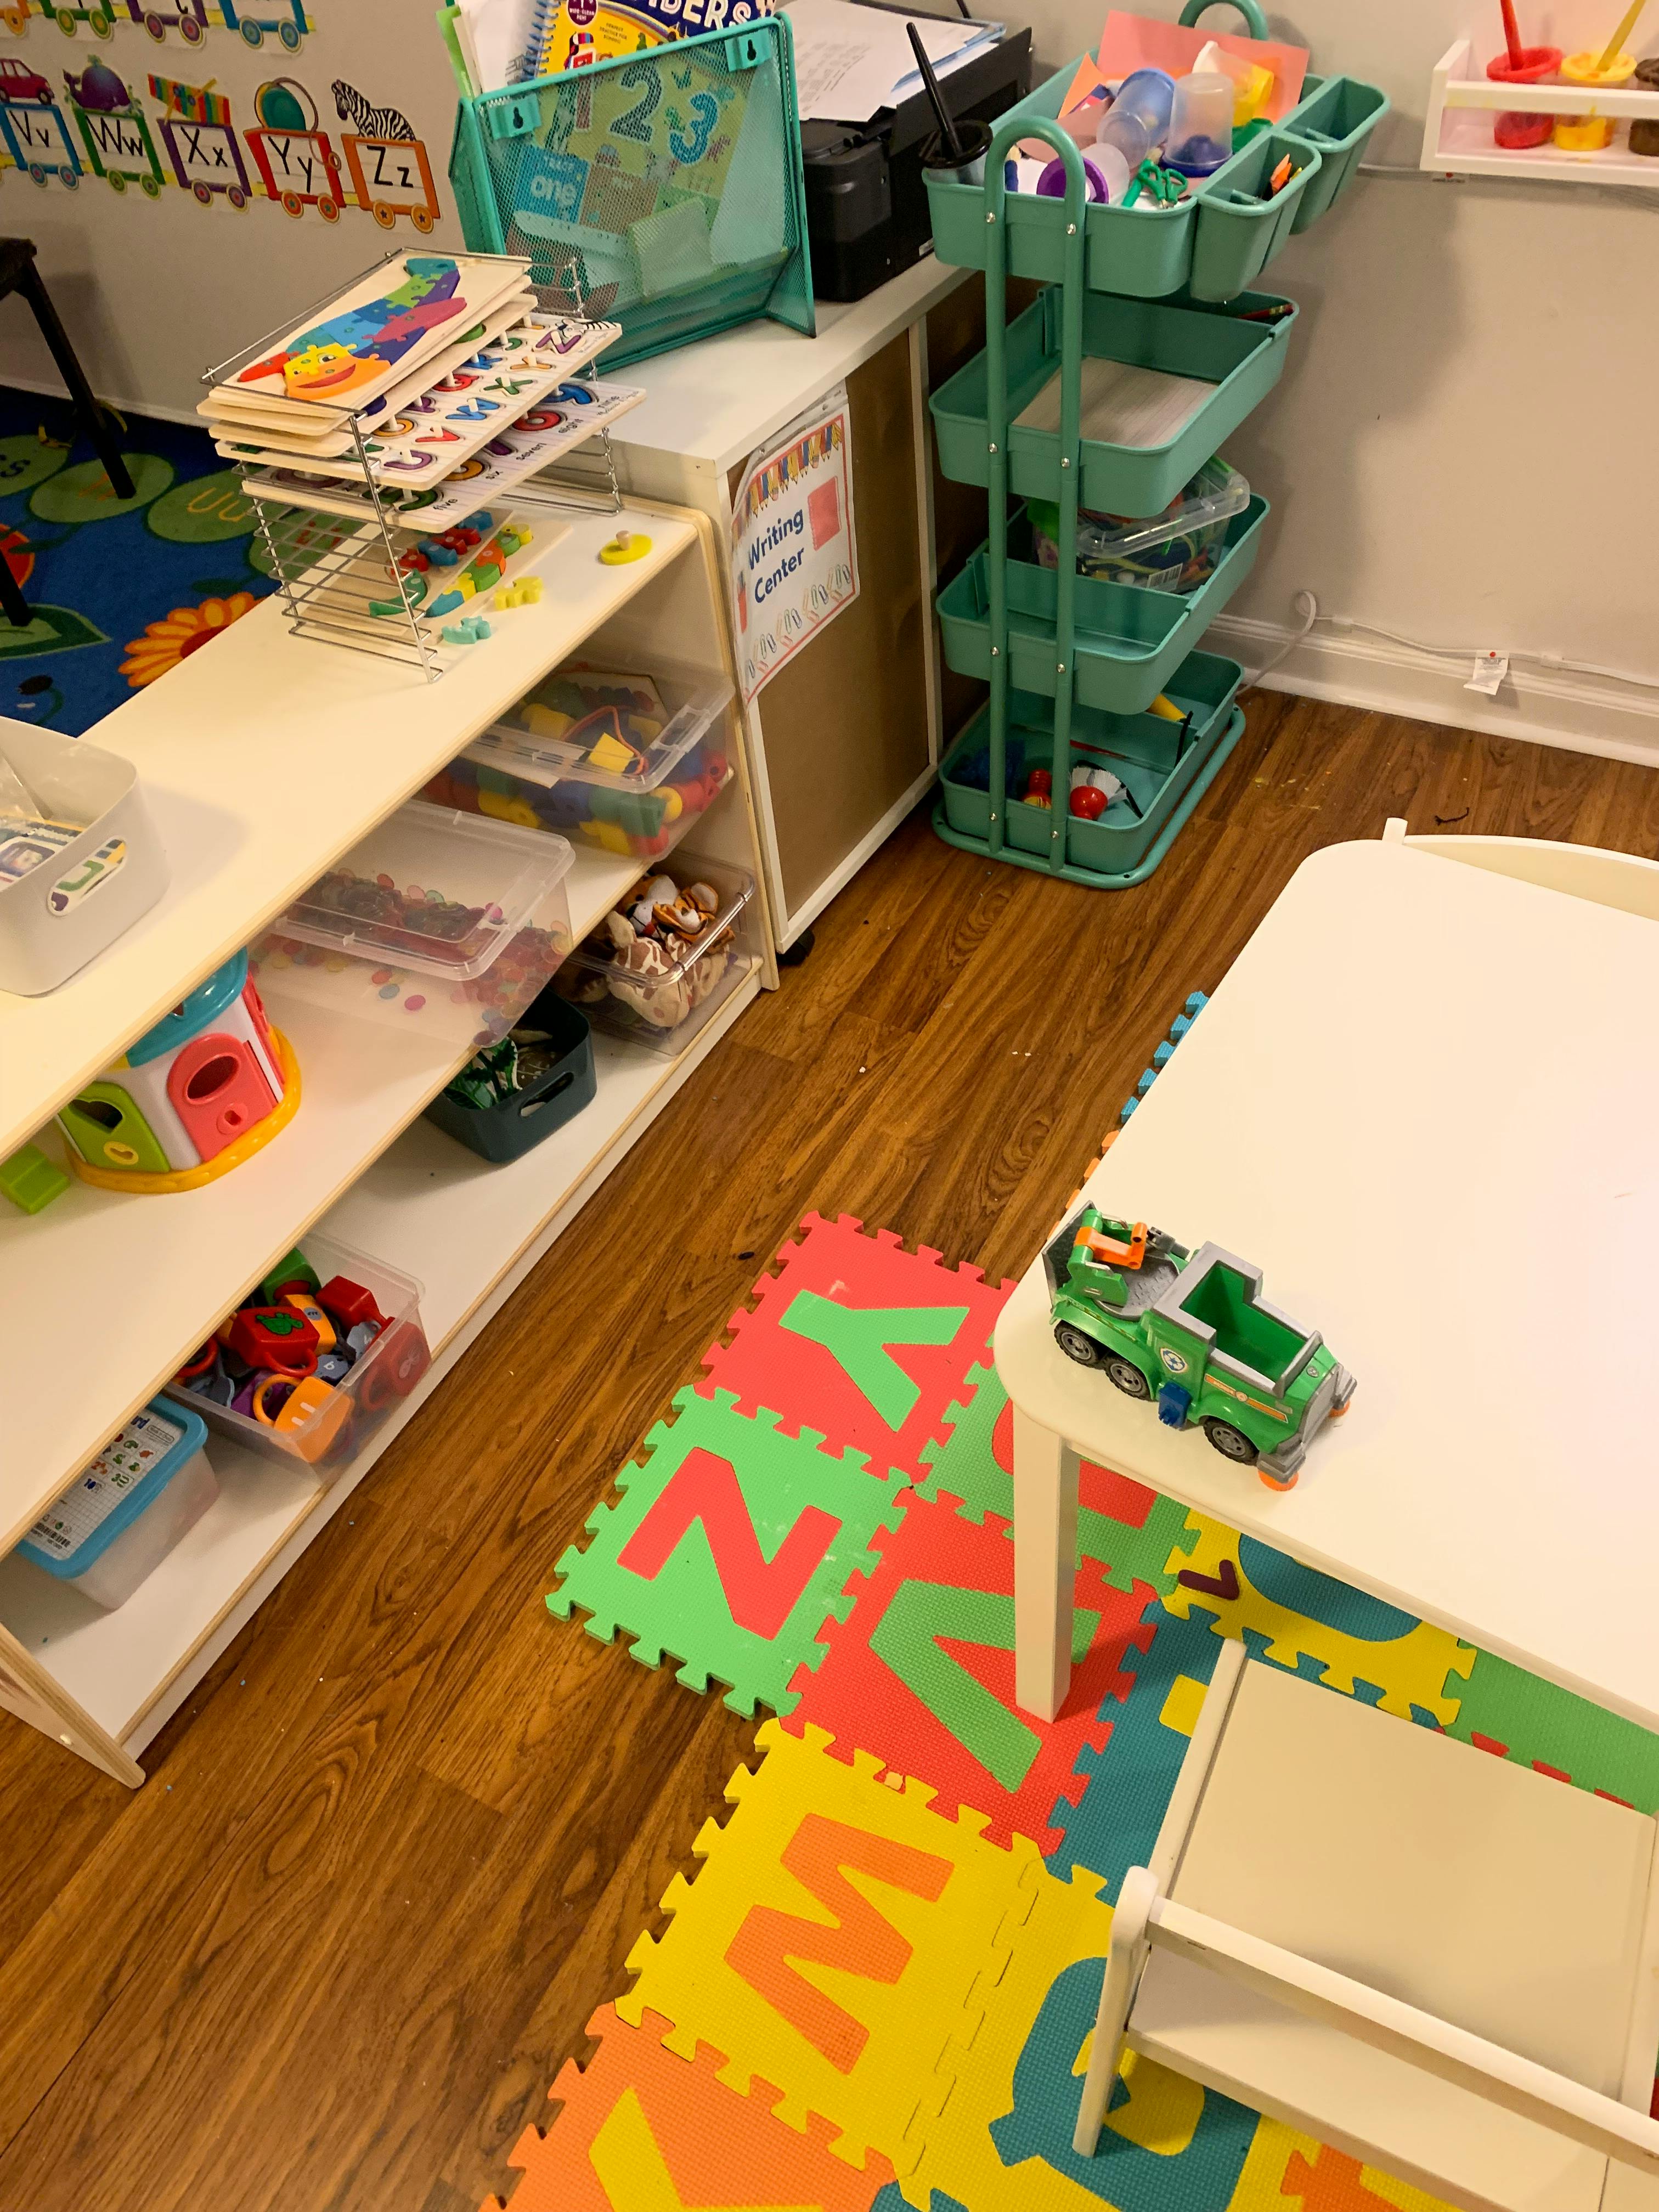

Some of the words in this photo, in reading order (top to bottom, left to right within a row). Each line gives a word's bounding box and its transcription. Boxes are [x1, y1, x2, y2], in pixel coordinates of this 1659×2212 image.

[10, 110, 50, 149] Vv
[609, 60, 662, 143] 2
[669, 92, 718, 164] 3
[86, 115, 144, 157] Ww
[180, 126, 228, 168] Xx
[268, 136, 313, 194] Yy
[366, 145, 416, 189] Zz
[558, 417, 584, 434] eight
[516, 442, 548, 461] seven
[485, 470, 504, 481] six
[433, 499, 458, 512] five
[747, 509, 805, 570] Writing
[754, 547, 805, 604] Center
